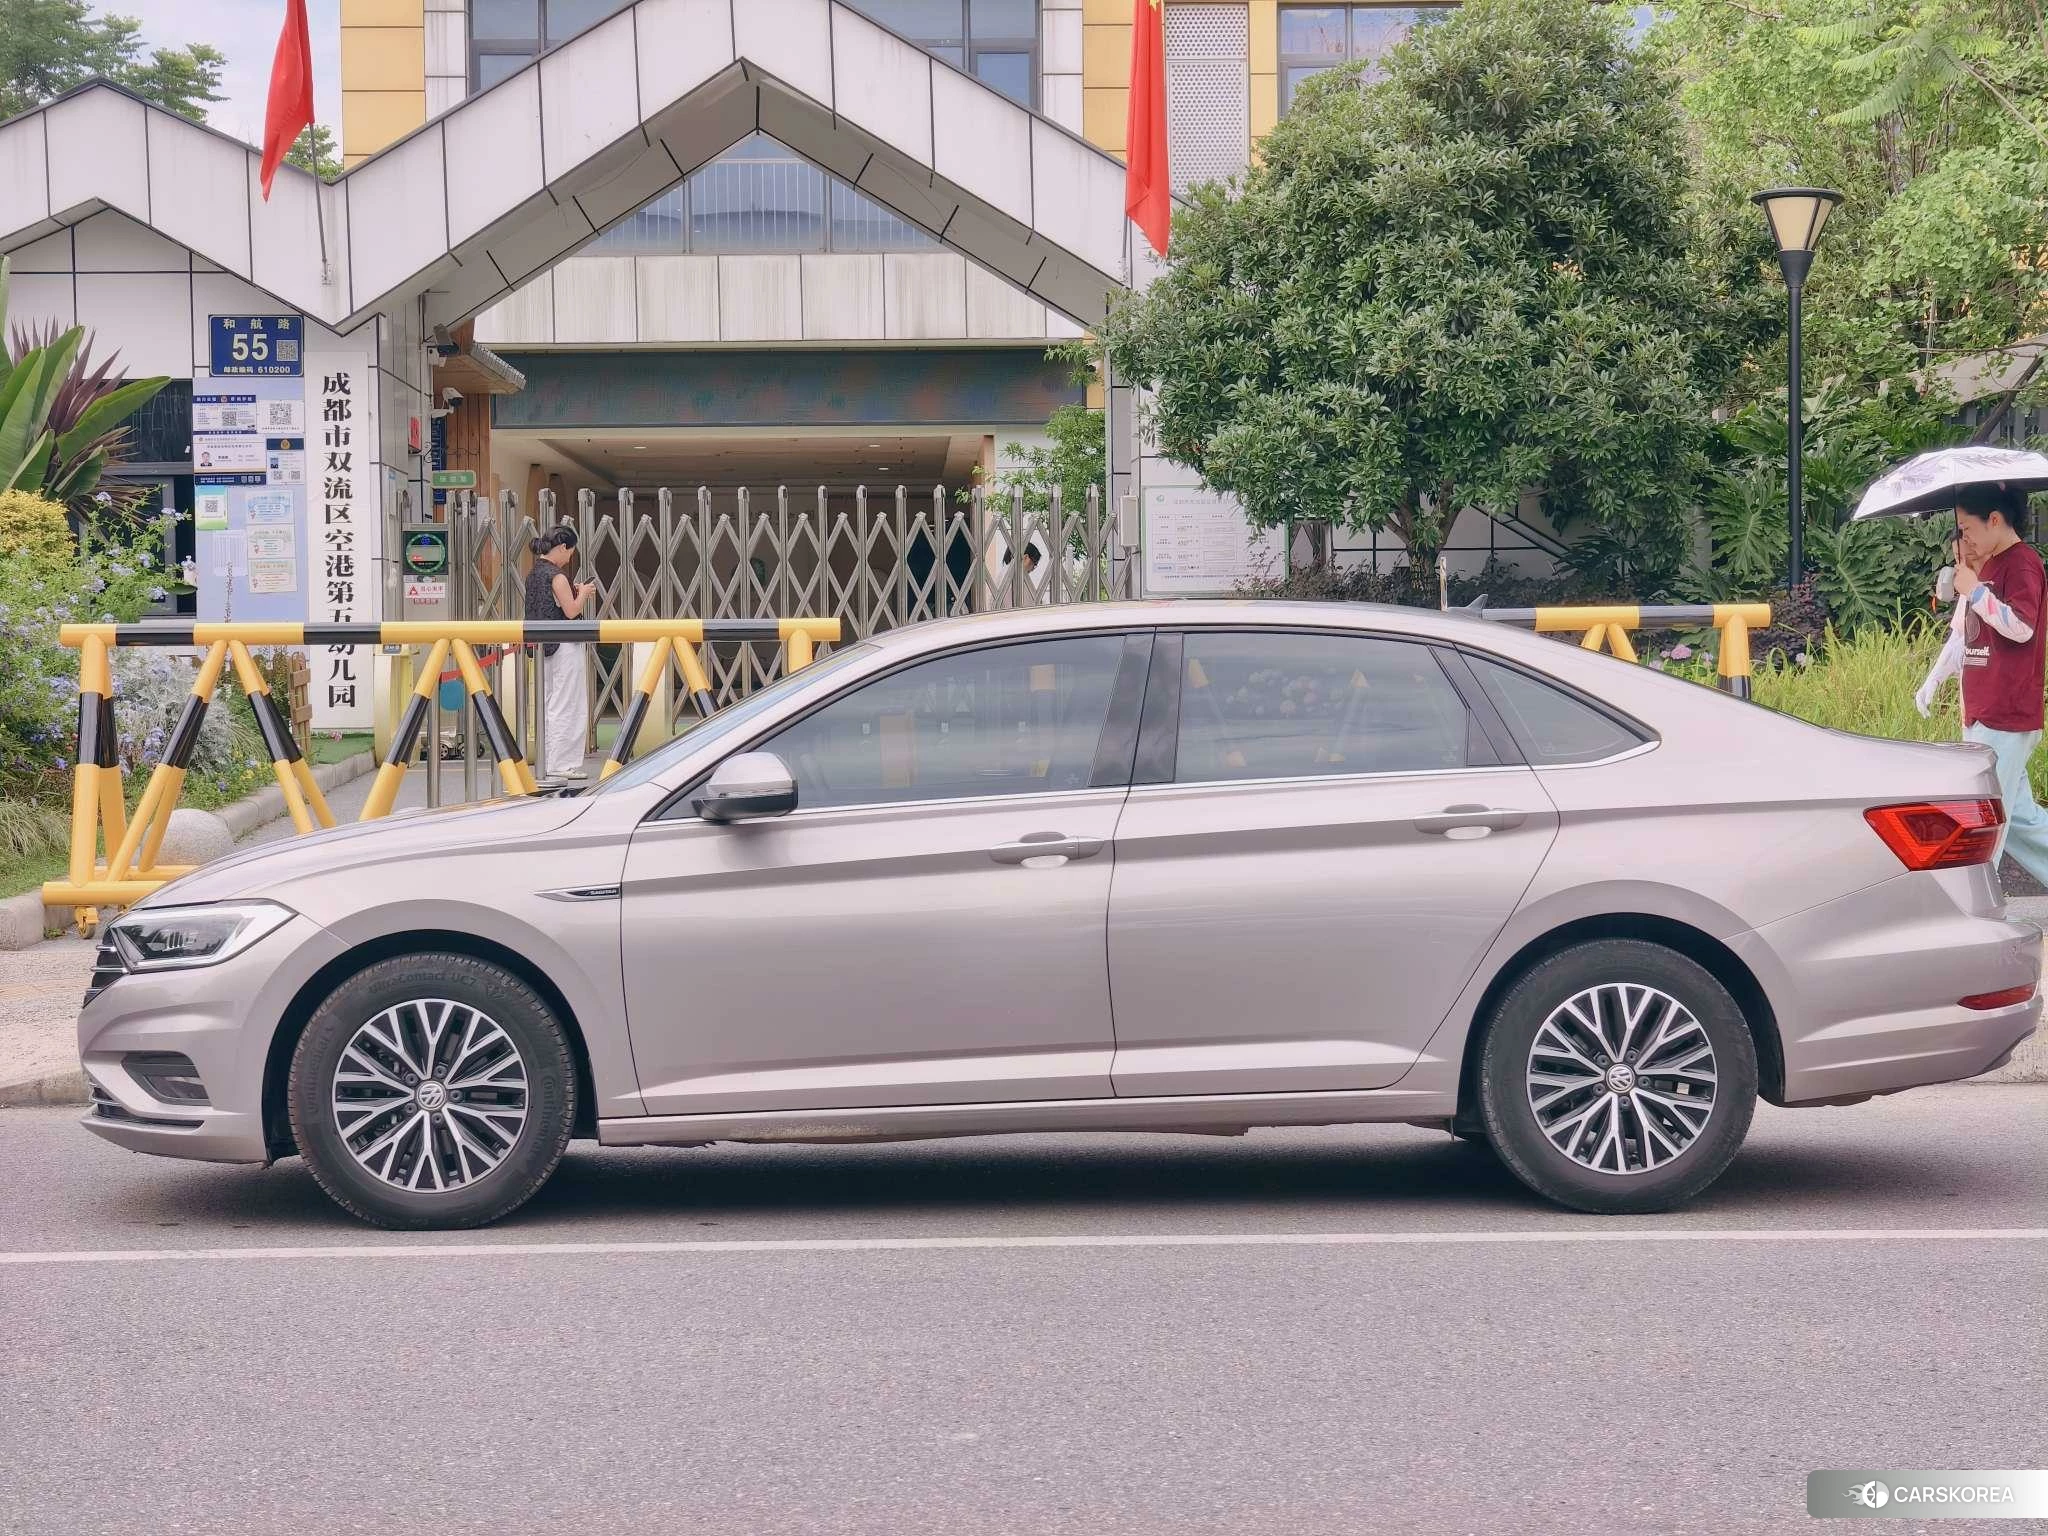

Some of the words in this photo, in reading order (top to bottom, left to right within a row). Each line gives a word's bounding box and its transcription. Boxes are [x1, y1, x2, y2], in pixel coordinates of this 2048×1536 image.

[223, 318, 290, 330] 和航路
[232, 333, 269, 361] 55
[257, 366, 291, 374] 610200
